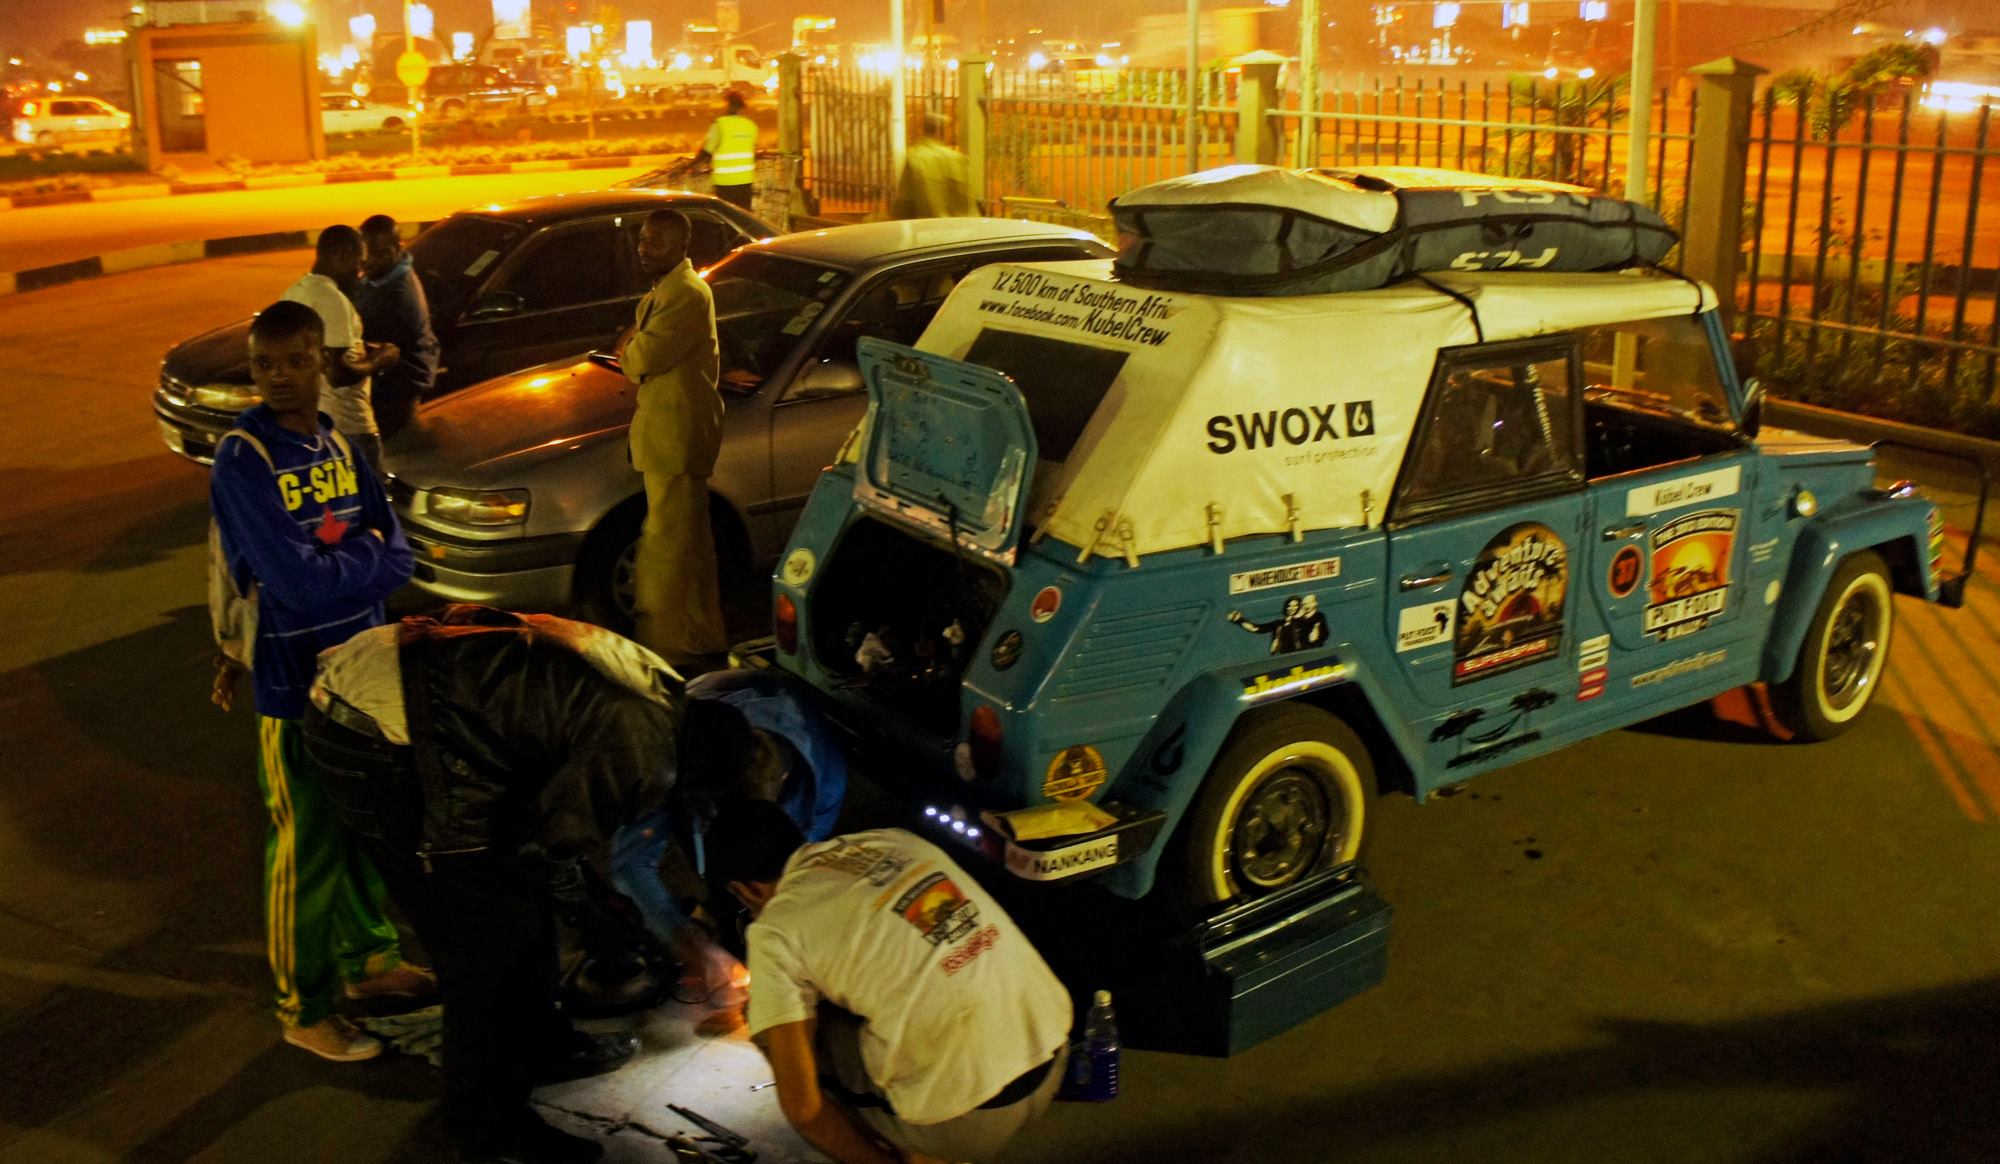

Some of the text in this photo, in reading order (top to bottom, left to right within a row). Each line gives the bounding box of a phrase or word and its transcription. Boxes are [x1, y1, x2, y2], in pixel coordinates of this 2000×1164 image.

[992, 271, 1011, 291] 12
[1009, 272, 1041, 297] 500
[1037, 277, 1059, 299] km
[1057, 283, 1079, 302] of
[1074, 283, 1137, 314] Southern
[1206, 404, 1340, 454] SWOX
[1651, 591, 1721, 627] PUT FOOT
[1033, 843, 1118, 874] NANKANG
